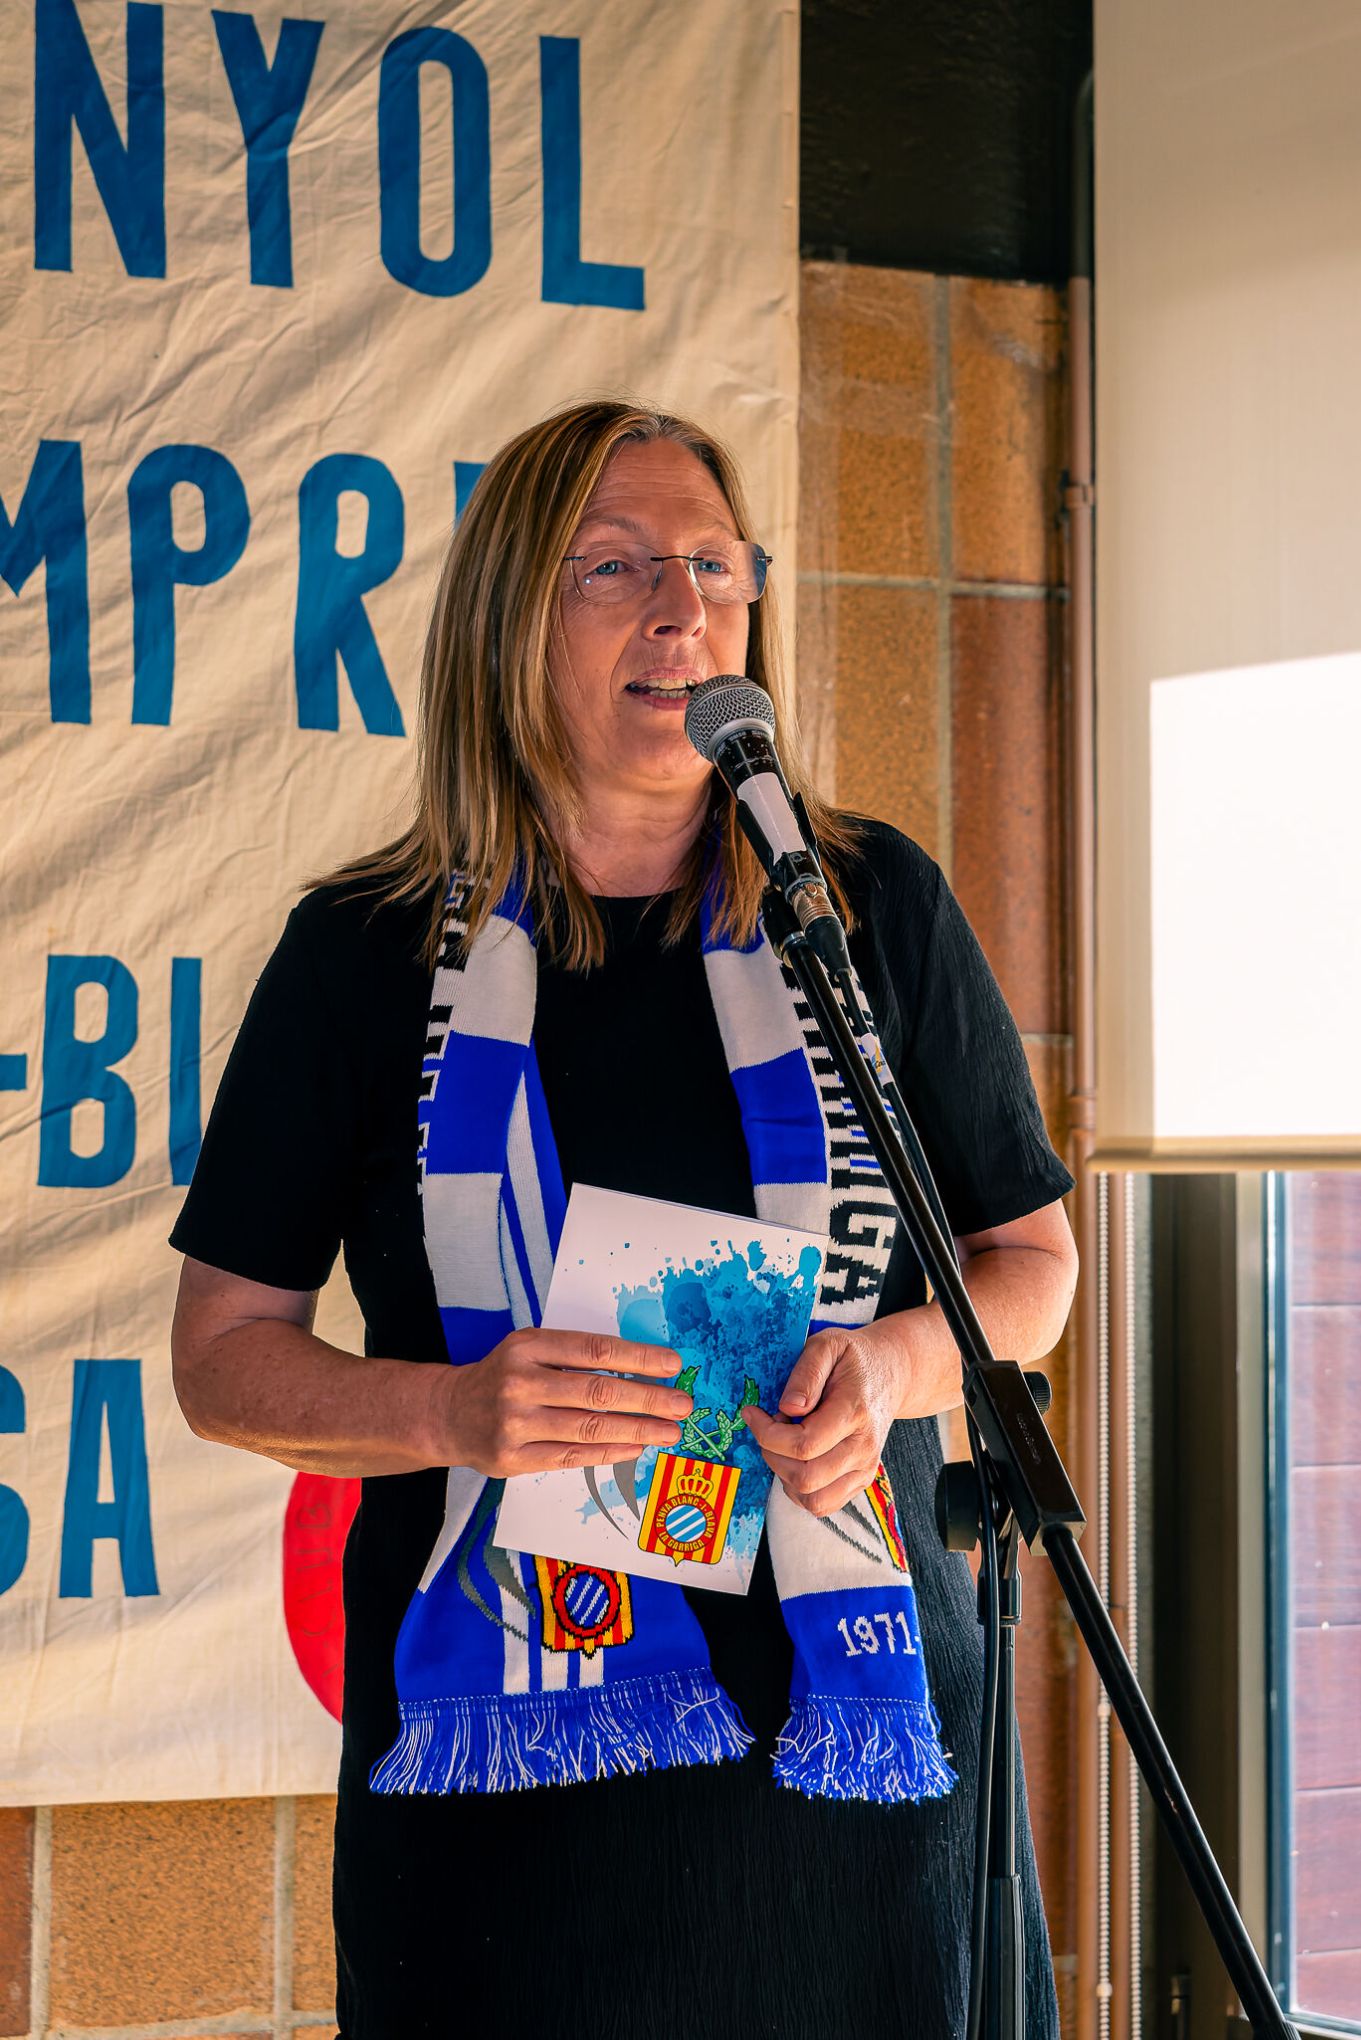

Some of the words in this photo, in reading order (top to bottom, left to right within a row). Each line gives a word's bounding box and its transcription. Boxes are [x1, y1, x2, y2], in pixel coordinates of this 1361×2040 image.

[34, 0, 646, 311] NYOL
[0, 439, 489, 738] MPR
[296, 1502, 337, 1637] CLUB
[656, 1502, 672, 1527] PENYA
[837, 1611, 917, 1657] 1971
